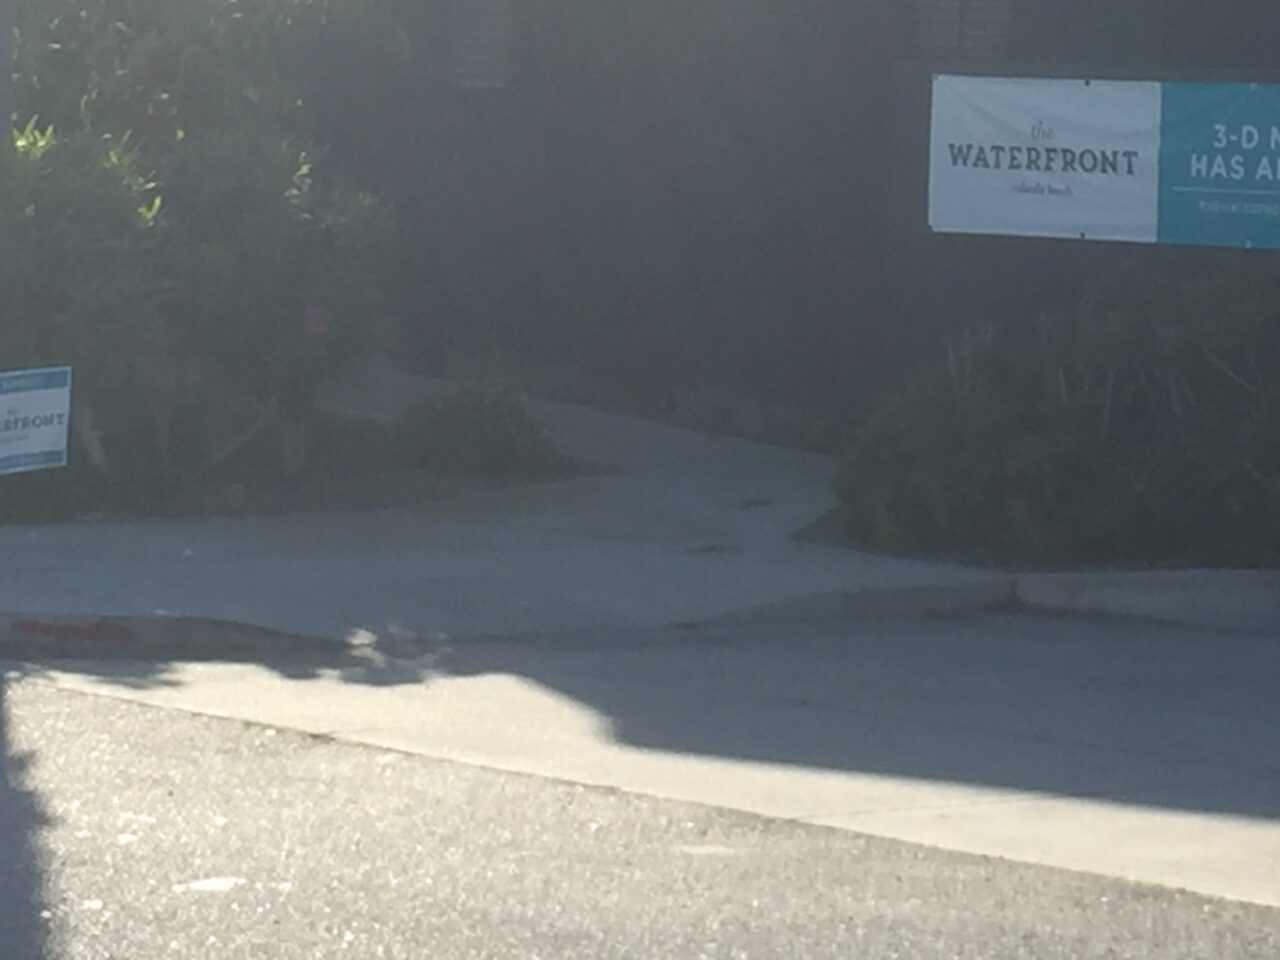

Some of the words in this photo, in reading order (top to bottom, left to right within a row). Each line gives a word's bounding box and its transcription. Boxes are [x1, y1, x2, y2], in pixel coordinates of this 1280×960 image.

[1213, 124, 1259, 150] 3-D
[948, 142, 1139, 175] WATERFRONT
[1190, 153, 1245, 180] HAS
